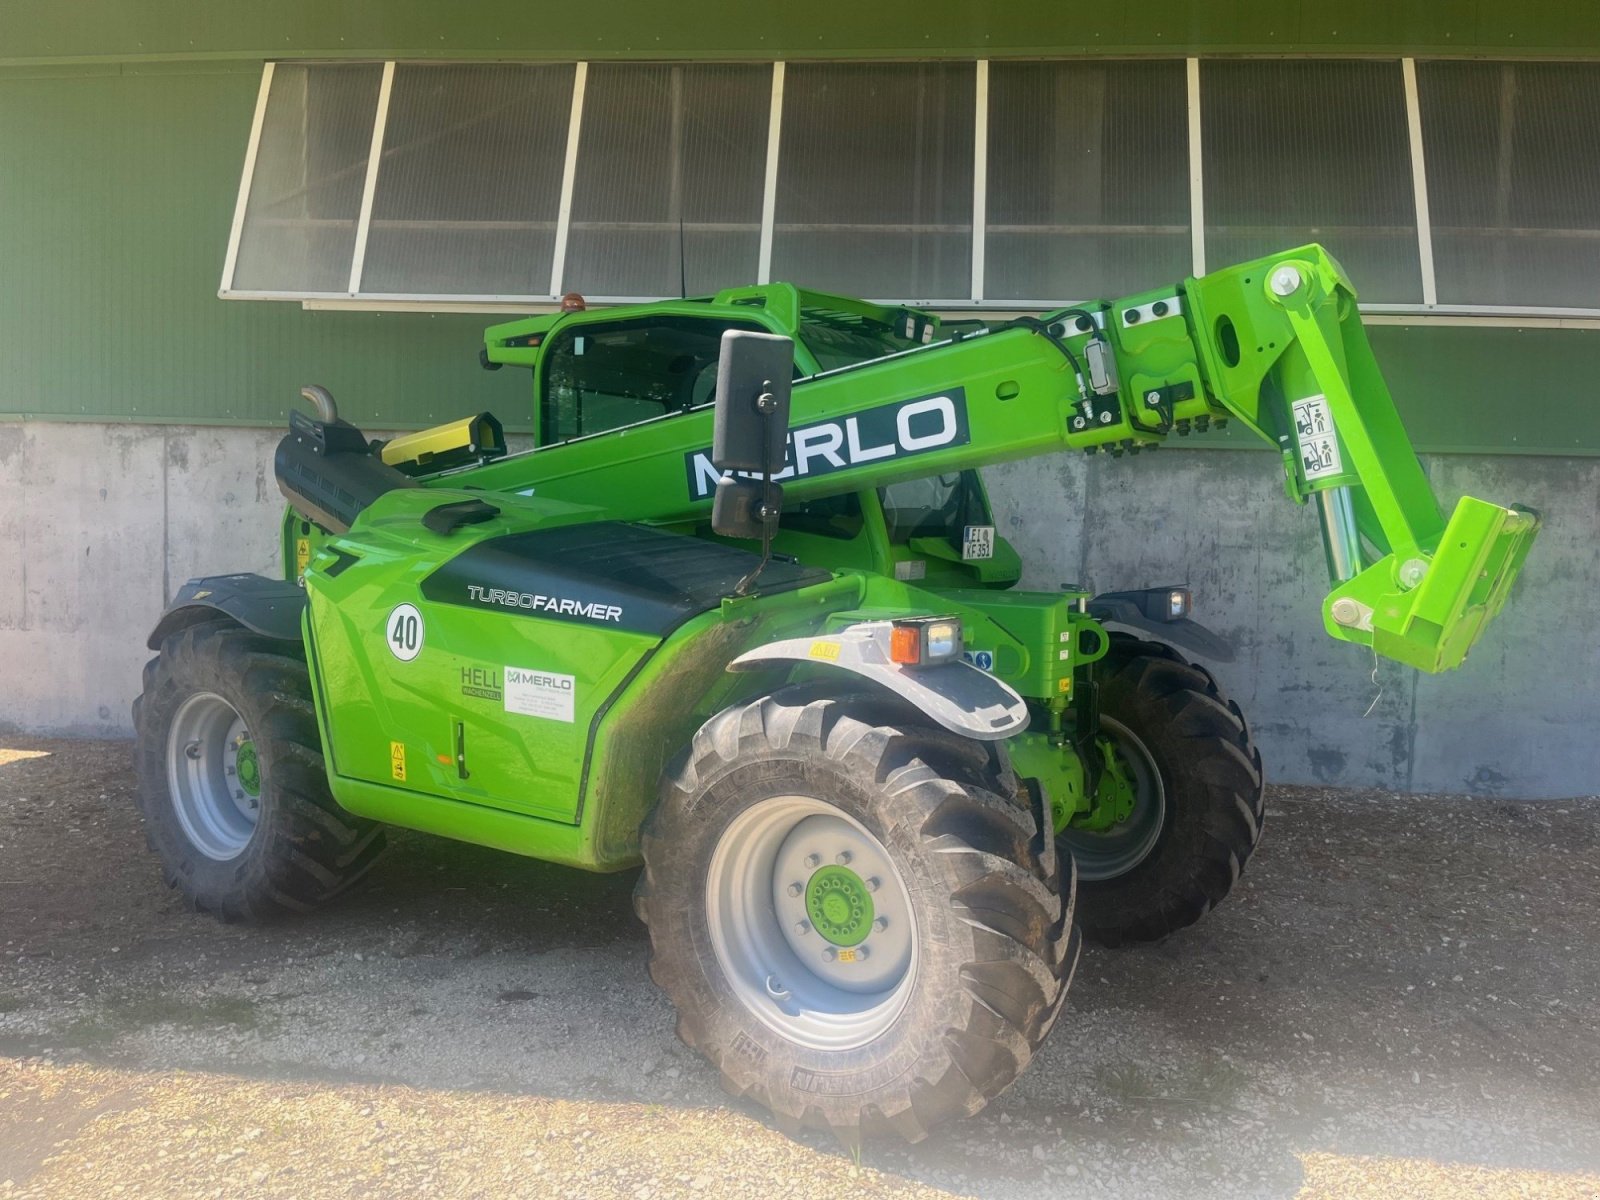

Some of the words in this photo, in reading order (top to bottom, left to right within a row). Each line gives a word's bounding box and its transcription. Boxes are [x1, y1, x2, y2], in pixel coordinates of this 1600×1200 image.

[468, 585, 623, 622] TURBOFARMER
[392, 615, 418, 651] 40
[461, 666, 502, 689] HELL
[522, 673, 572, 690] MERLO
